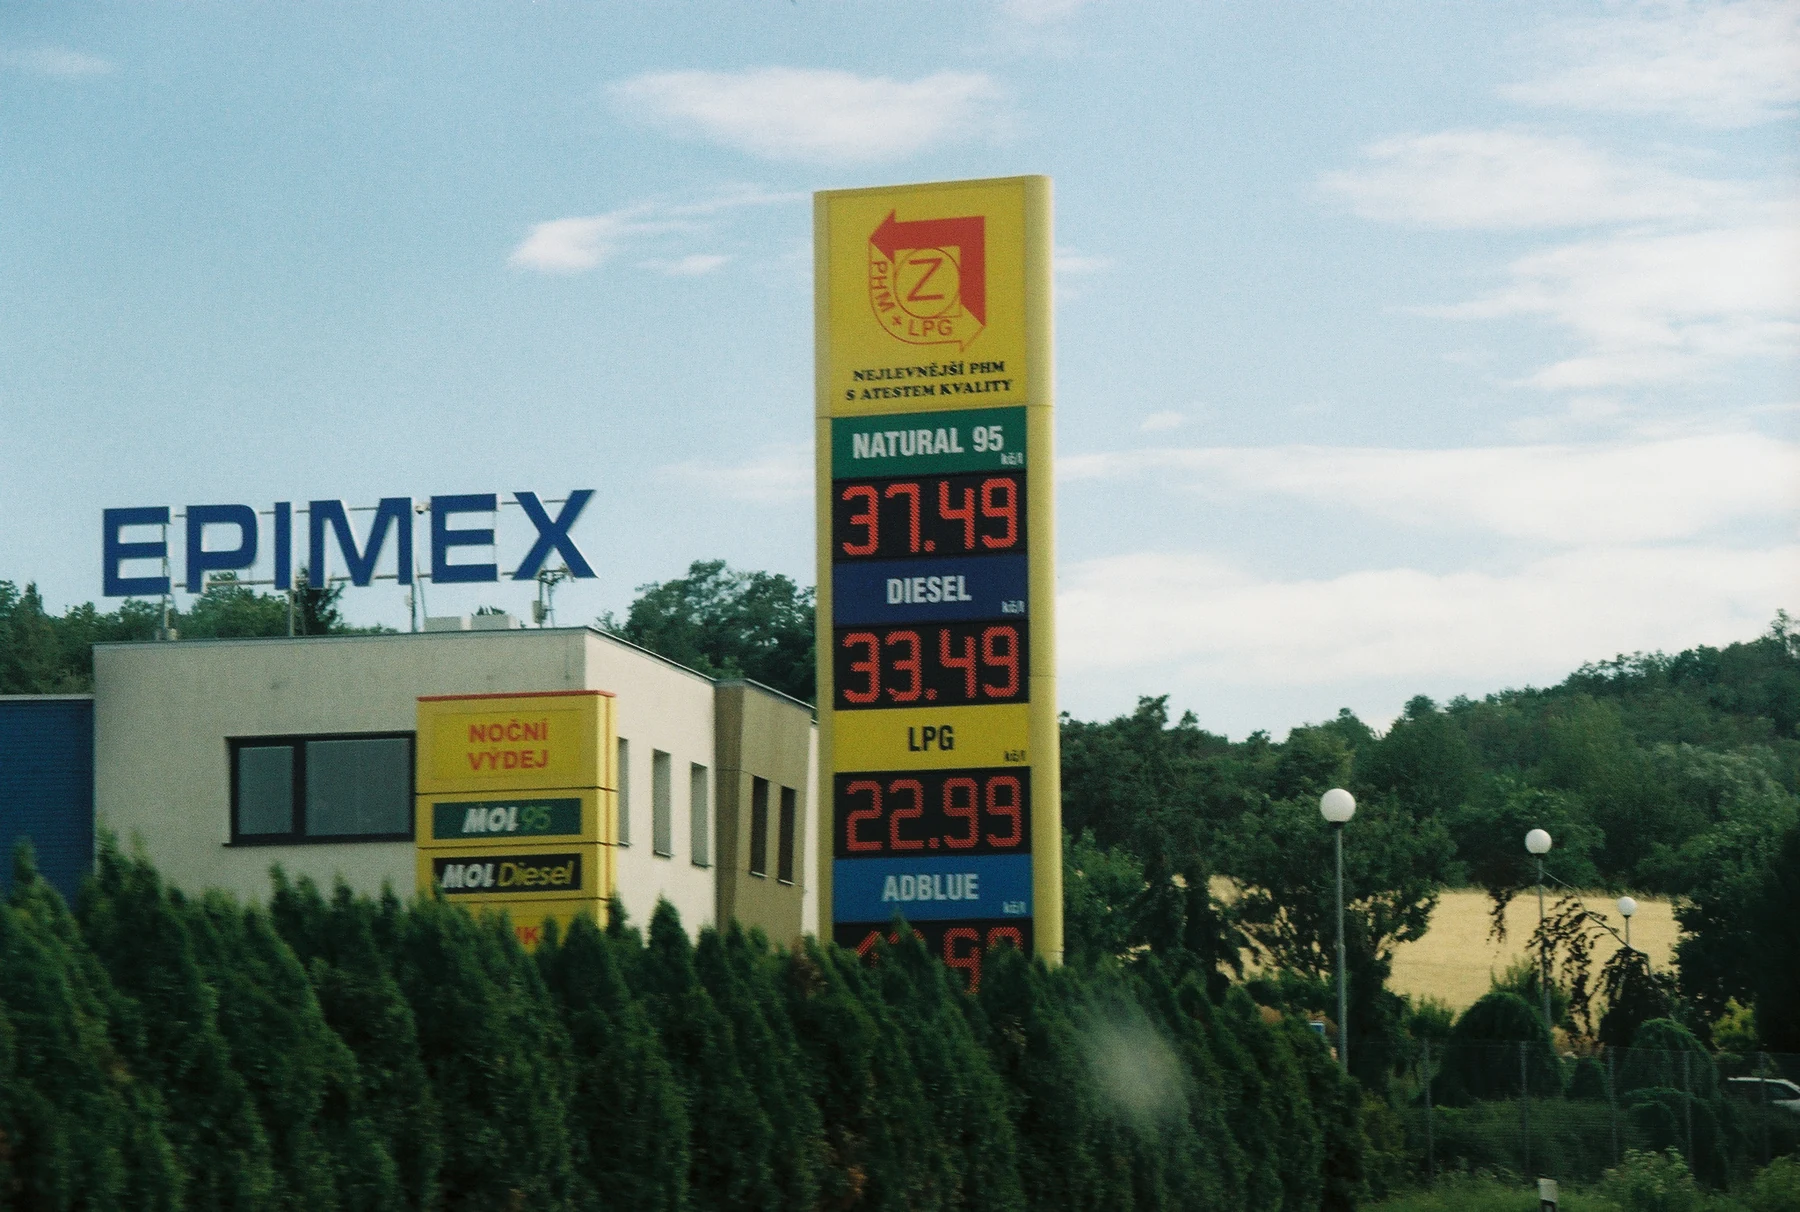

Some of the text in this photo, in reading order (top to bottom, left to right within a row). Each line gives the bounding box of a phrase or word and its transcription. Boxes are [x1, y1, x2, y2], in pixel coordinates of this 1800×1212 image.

[906, 258, 945, 302] Z
[870, 259, 953, 338] PHM LPG
[853, 360, 1006, 382] NEJLEVNĚJŠÍ PHM
[845, 379, 1012, 401] S ATESTEM KVALITY
[852, 425, 1004, 459] NATURAL 95
[842, 477, 1017, 555] 37.49
[102, 488, 600, 597] EPIMEX
[887, 575, 972, 604] DIESEL
[842, 626, 1020, 703] 33.49
[468, 718, 549, 743] NOČNÍ
[908, 724, 954, 752] LPG
[467, 748, 549, 771] VÝDEJ
[462, 806, 551, 833] MOL 95
[846, 775, 1022, 851] 22.99
[441, 860, 575, 889] MOL Diesel
[882, 874, 980, 901] ADBLUE
